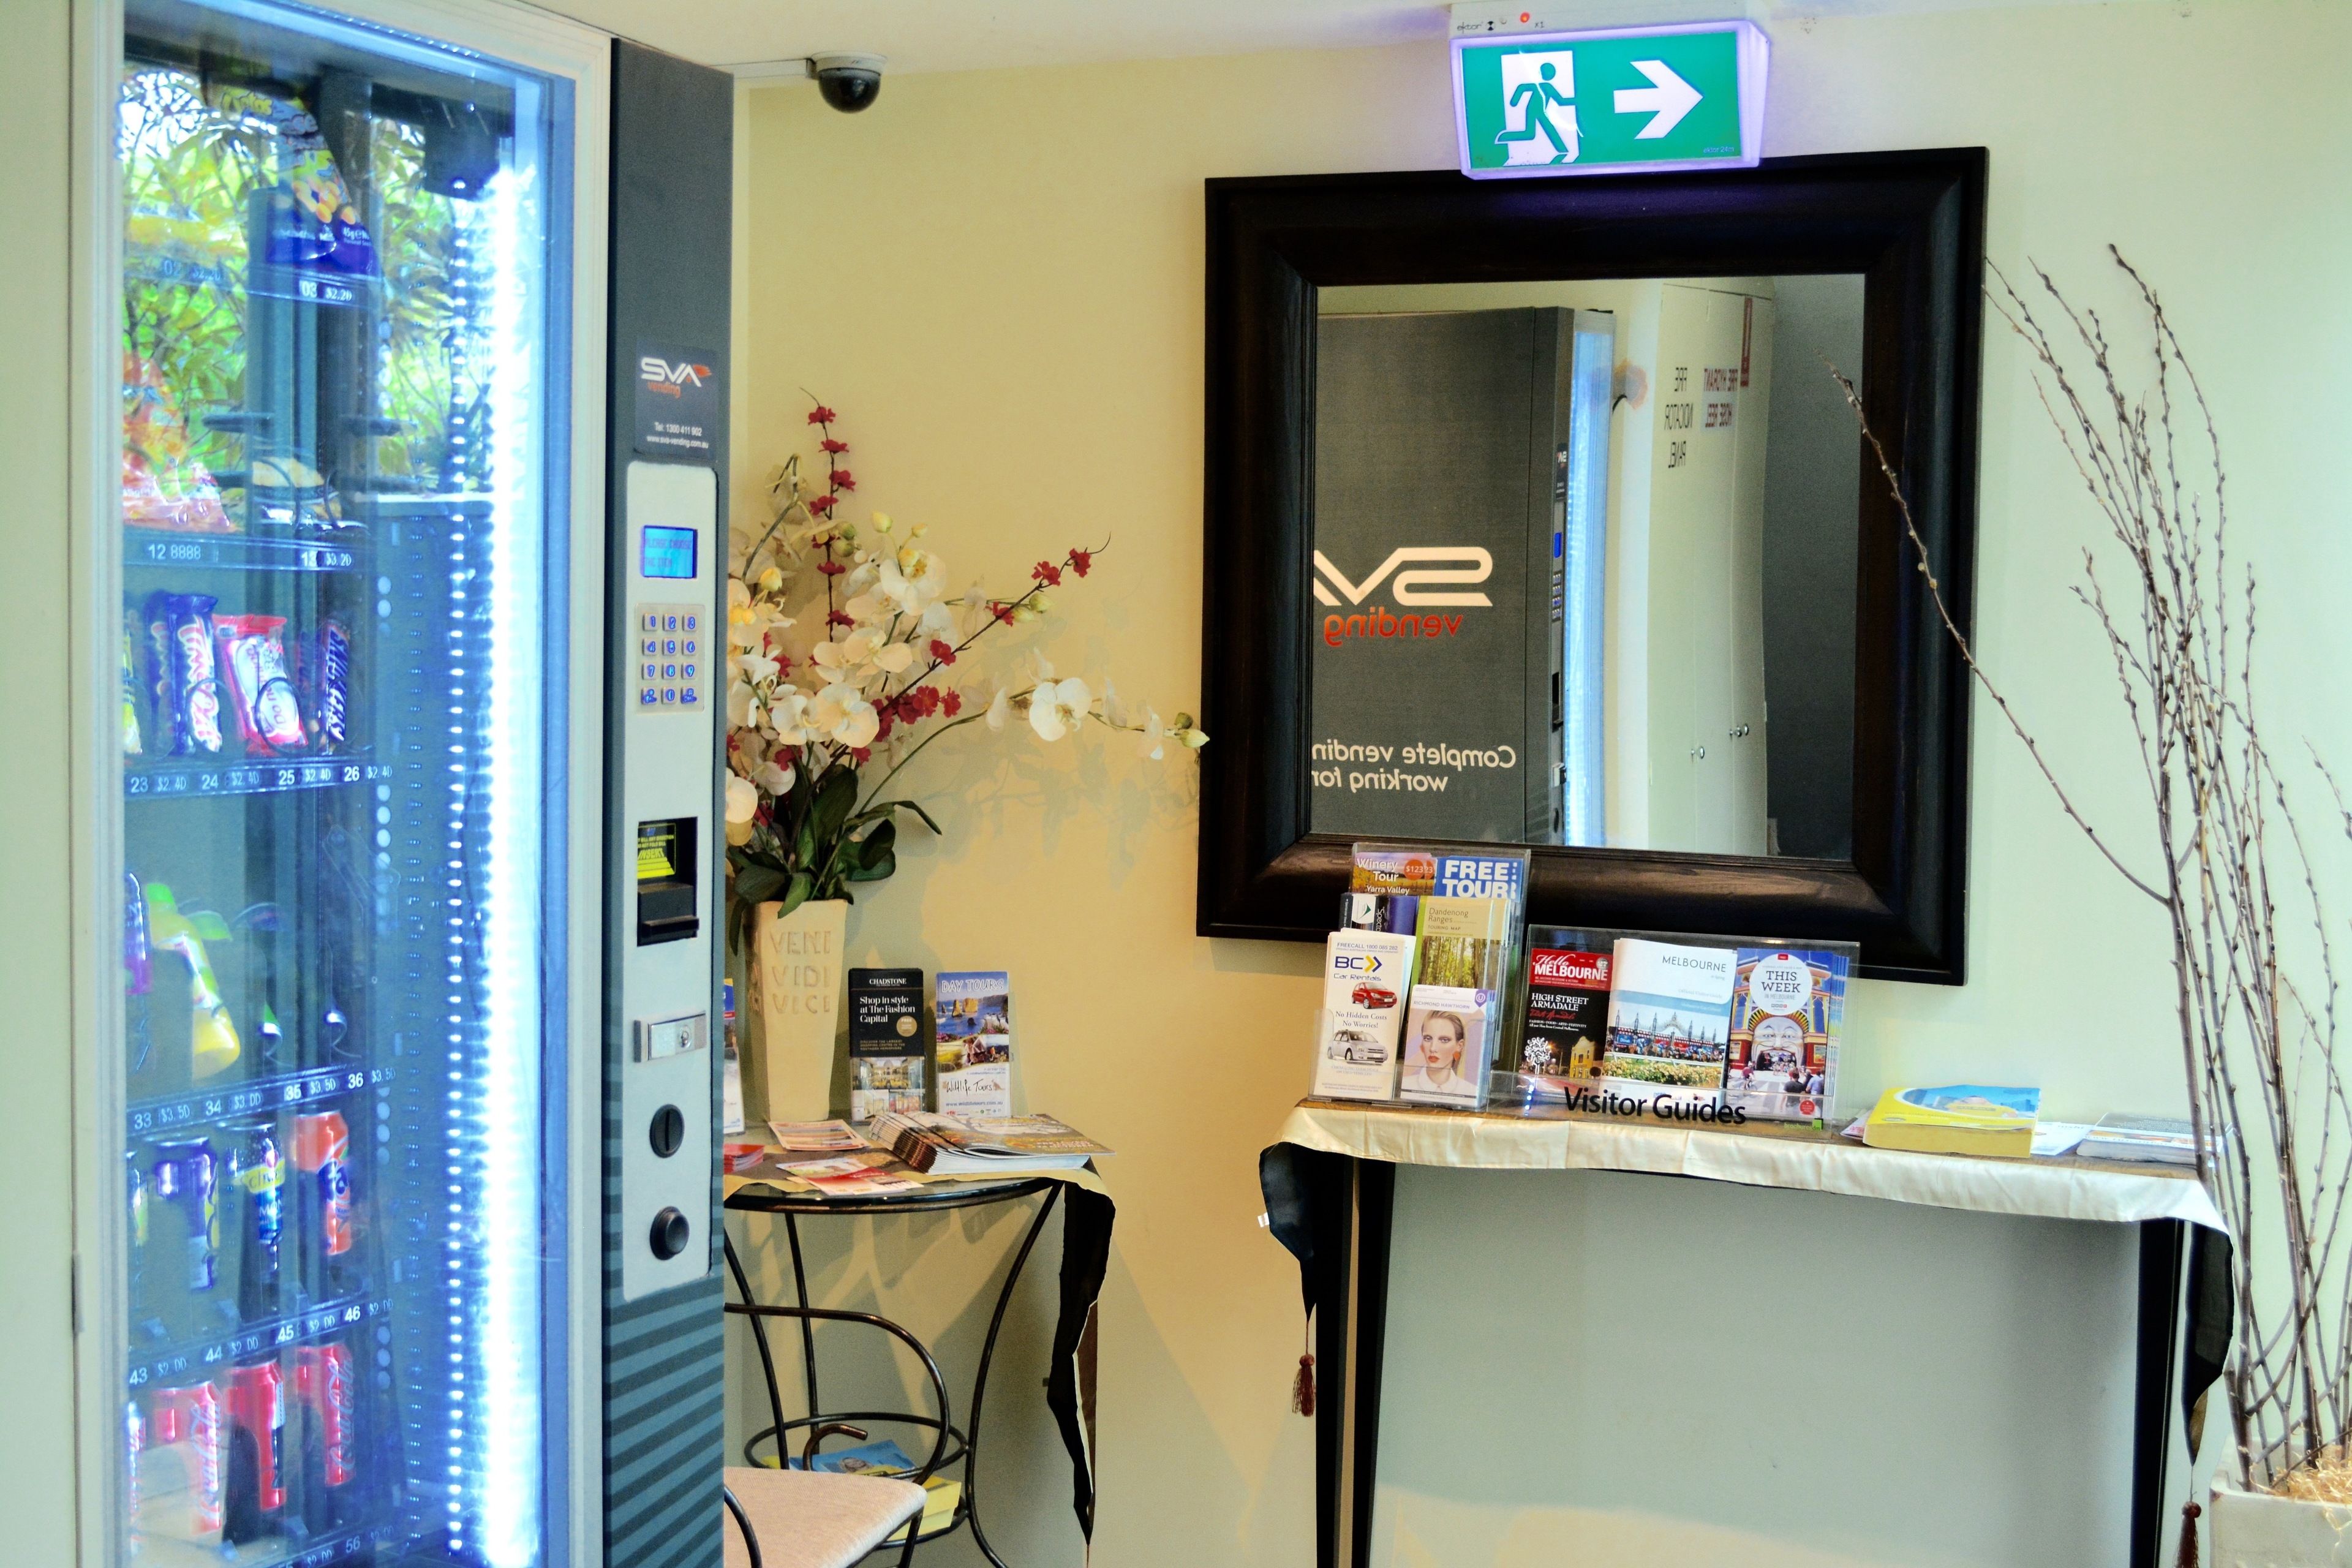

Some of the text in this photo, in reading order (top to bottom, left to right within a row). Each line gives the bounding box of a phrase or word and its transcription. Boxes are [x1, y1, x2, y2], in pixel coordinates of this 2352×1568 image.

[326, 288, 352, 302] $2.20
[680, 426, 690, 434] 411
[691, 427, 703, 437] 902
[148, 544, 166, 560] 12
[327, 629, 349, 742] SNICKERS
[202, 774, 219, 790] 24
[279, 770, 295, 785] 25
[344, 766, 360, 782] 26
[131, 777, 148, 793] 23
[638, 848, 665, 860] INSERT
[1356, 858, 1398, 872] Winery
[1445, 859, 1509, 881] FREE
[1373, 871, 1399, 882] Tour
[1387, 886, 1409, 895] Valley
[1428, 914, 1452, 924] Ranges
[1429, 907, 1469, 918] Dandenong
[769, 931, 831, 954] VENI
[1335, 956, 1364, 970] BC
[1532, 954, 1576, 966] Hello
[1662, 955, 1727, 973] MELBOURNE
[772, 965, 831, 988] VIDI
[1534, 963, 1608, 981] MELBOURNE
[1766, 971, 1797, 981] THIS
[941, 978, 1004, 993] DAY TOURS
[1761, 982, 1801, 993] WEEK
[772, 993, 831, 1014] VICI
[859, 995, 908, 1006] Shop in style
[1531, 993, 1589, 1005] HIGH STREET
[1531, 1000, 1579, 1011] ARMADALE
[869, 1005, 884, 1014] The
[885, 1005, 916, 1014] Fashion
[860, 1014, 888, 1025] Capital
[310, 1077, 336, 1095] $3.50
[348, 1073, 364, 1089] 36
[946, 1079, 992, 1096] Wildlife Tours
[206, 1099, 222, 1116] 34
[1564, 1086, 1746, 1125] Visitor Guides
[134, 1112, 153, 1129] 33
[345, 1305, 361, 1323] 46
[277, 1325, 295, 1343] 45
[206, 1345, 222, 1363] 44
[129, 1368, 148, 1386] 43
[345, 1536, 361, 1554] 56
